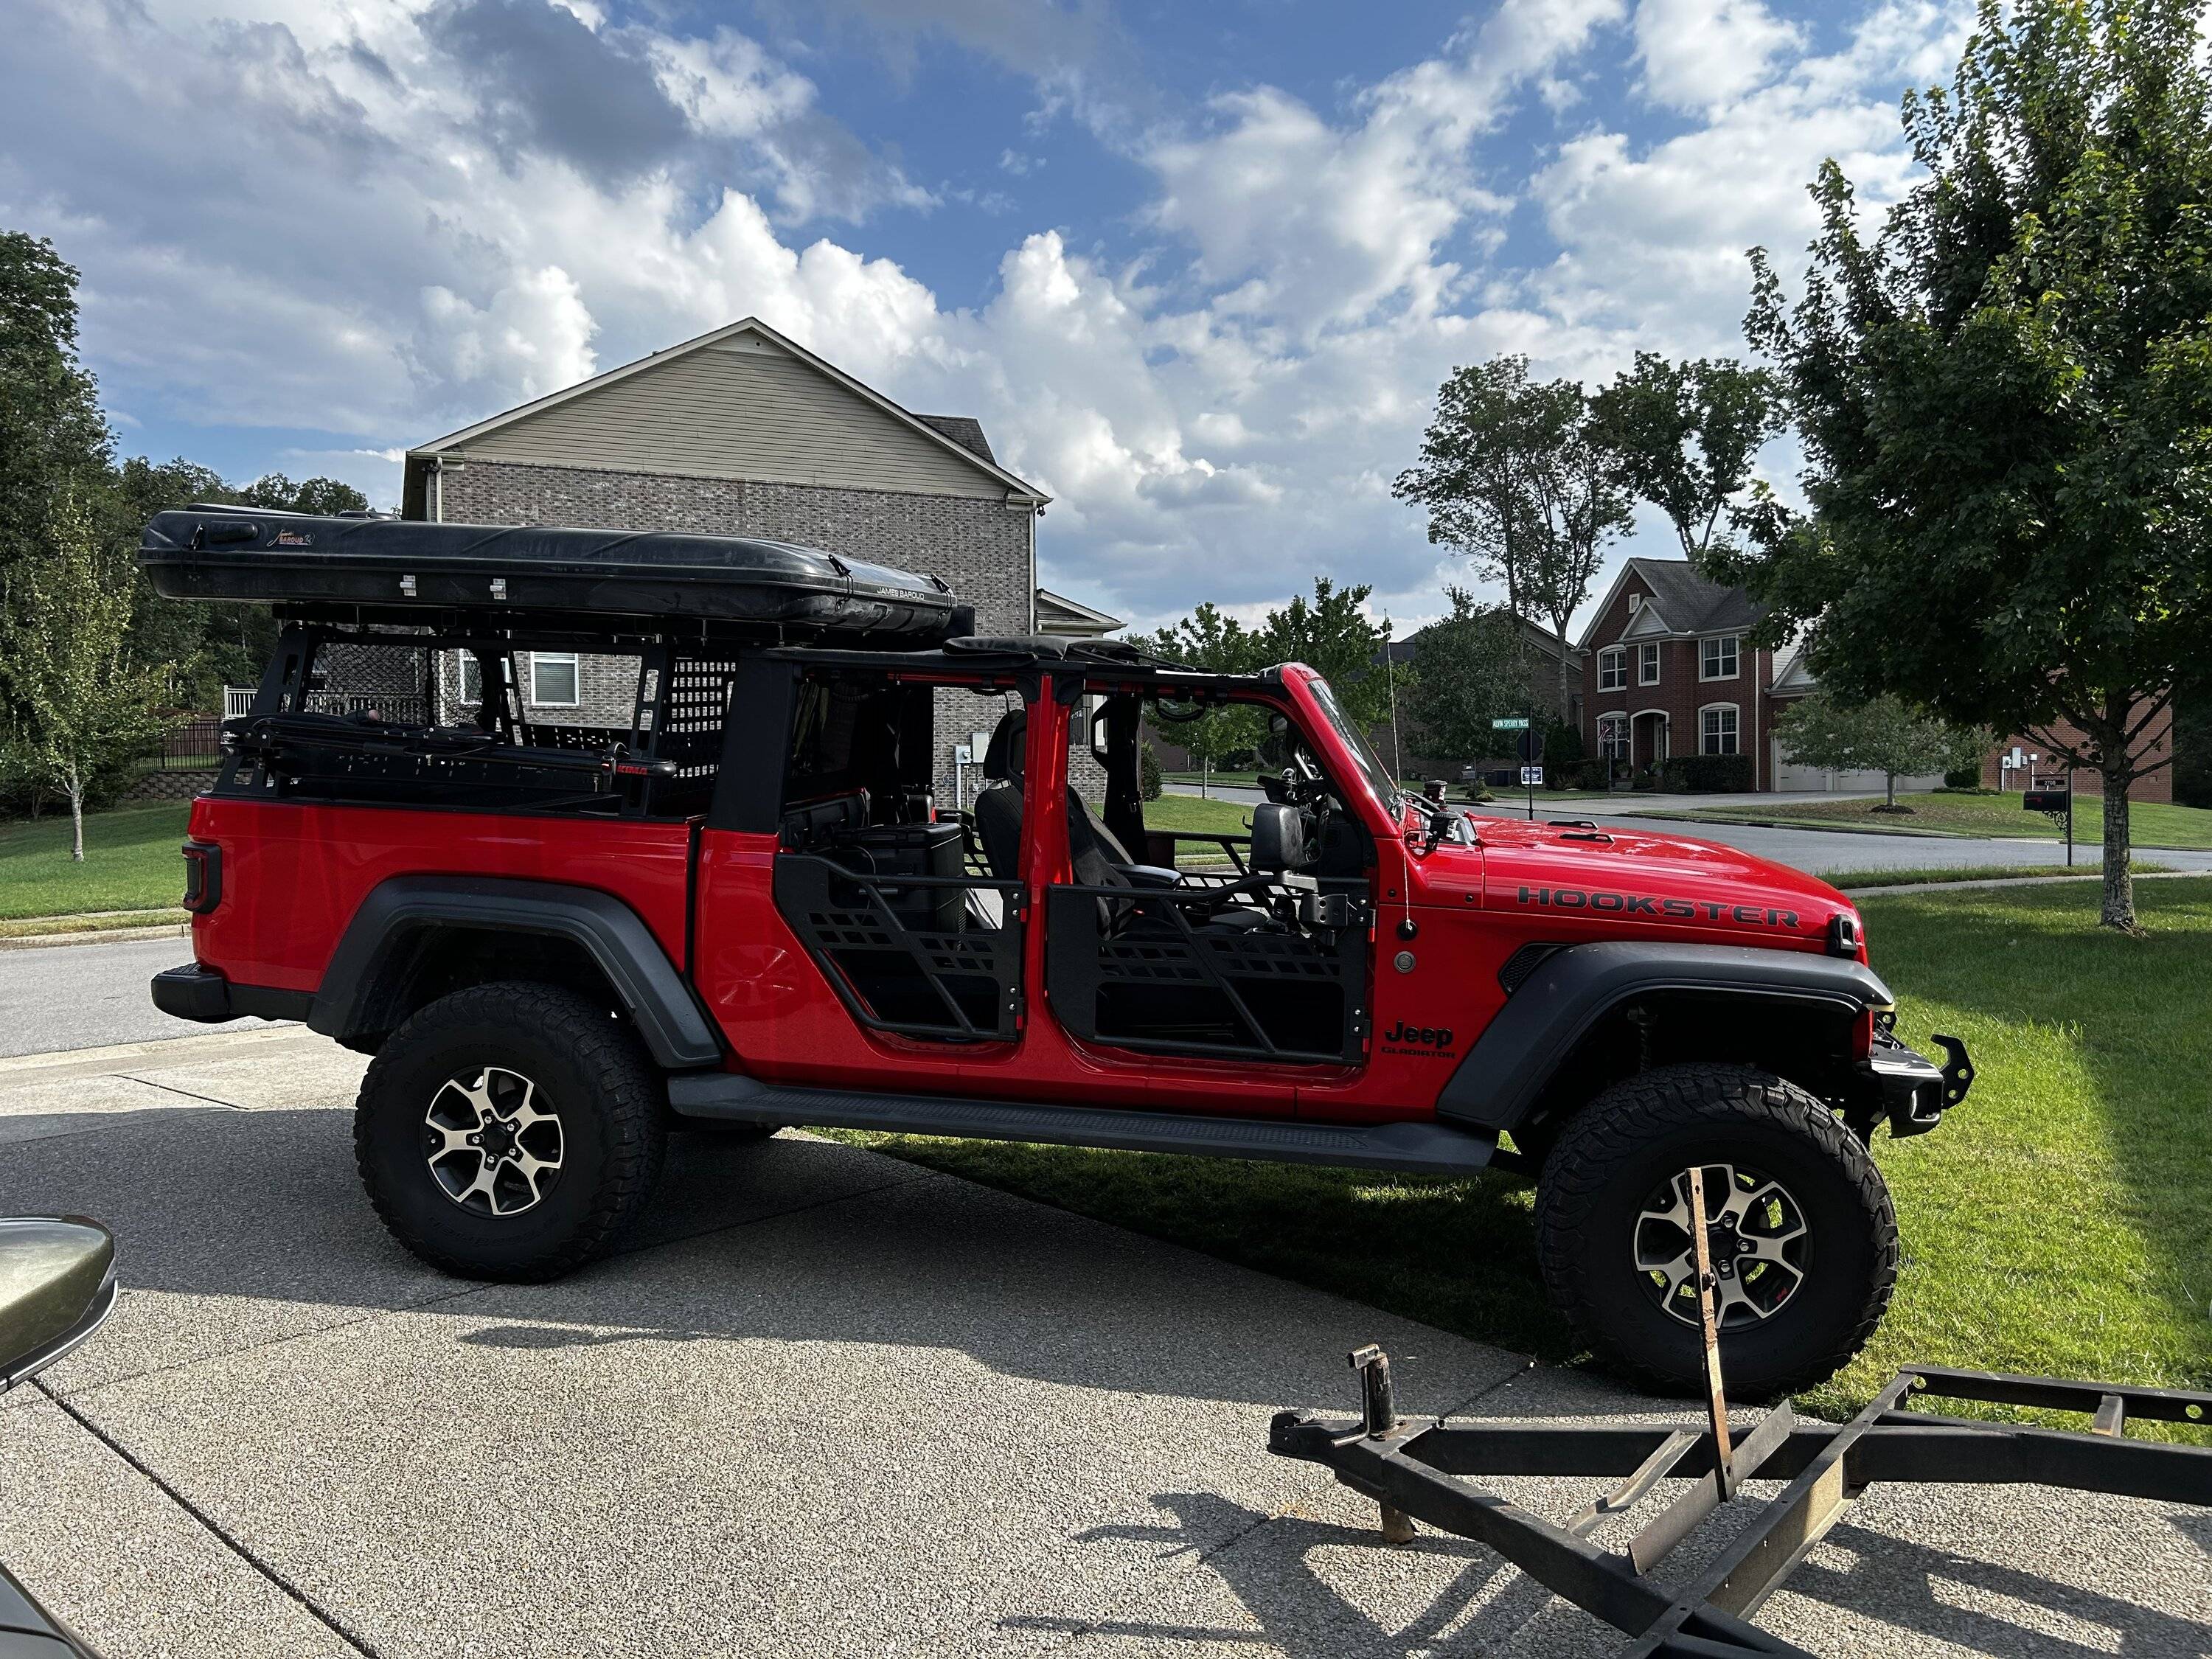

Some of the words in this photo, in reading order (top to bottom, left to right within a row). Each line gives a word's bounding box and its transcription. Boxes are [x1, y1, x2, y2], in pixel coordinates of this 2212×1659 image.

[877, 586, 899, 597] JAMES
[900, 590, 925, 600] BAROUD
[1518, 719, 1528, 727] PASS
[1516, 886, 1803, 929] HOOKSTER
[1385, 1020, 1453, 1048] Jeep
[1380, 1047, 1456, 1059] GLADIATOR
